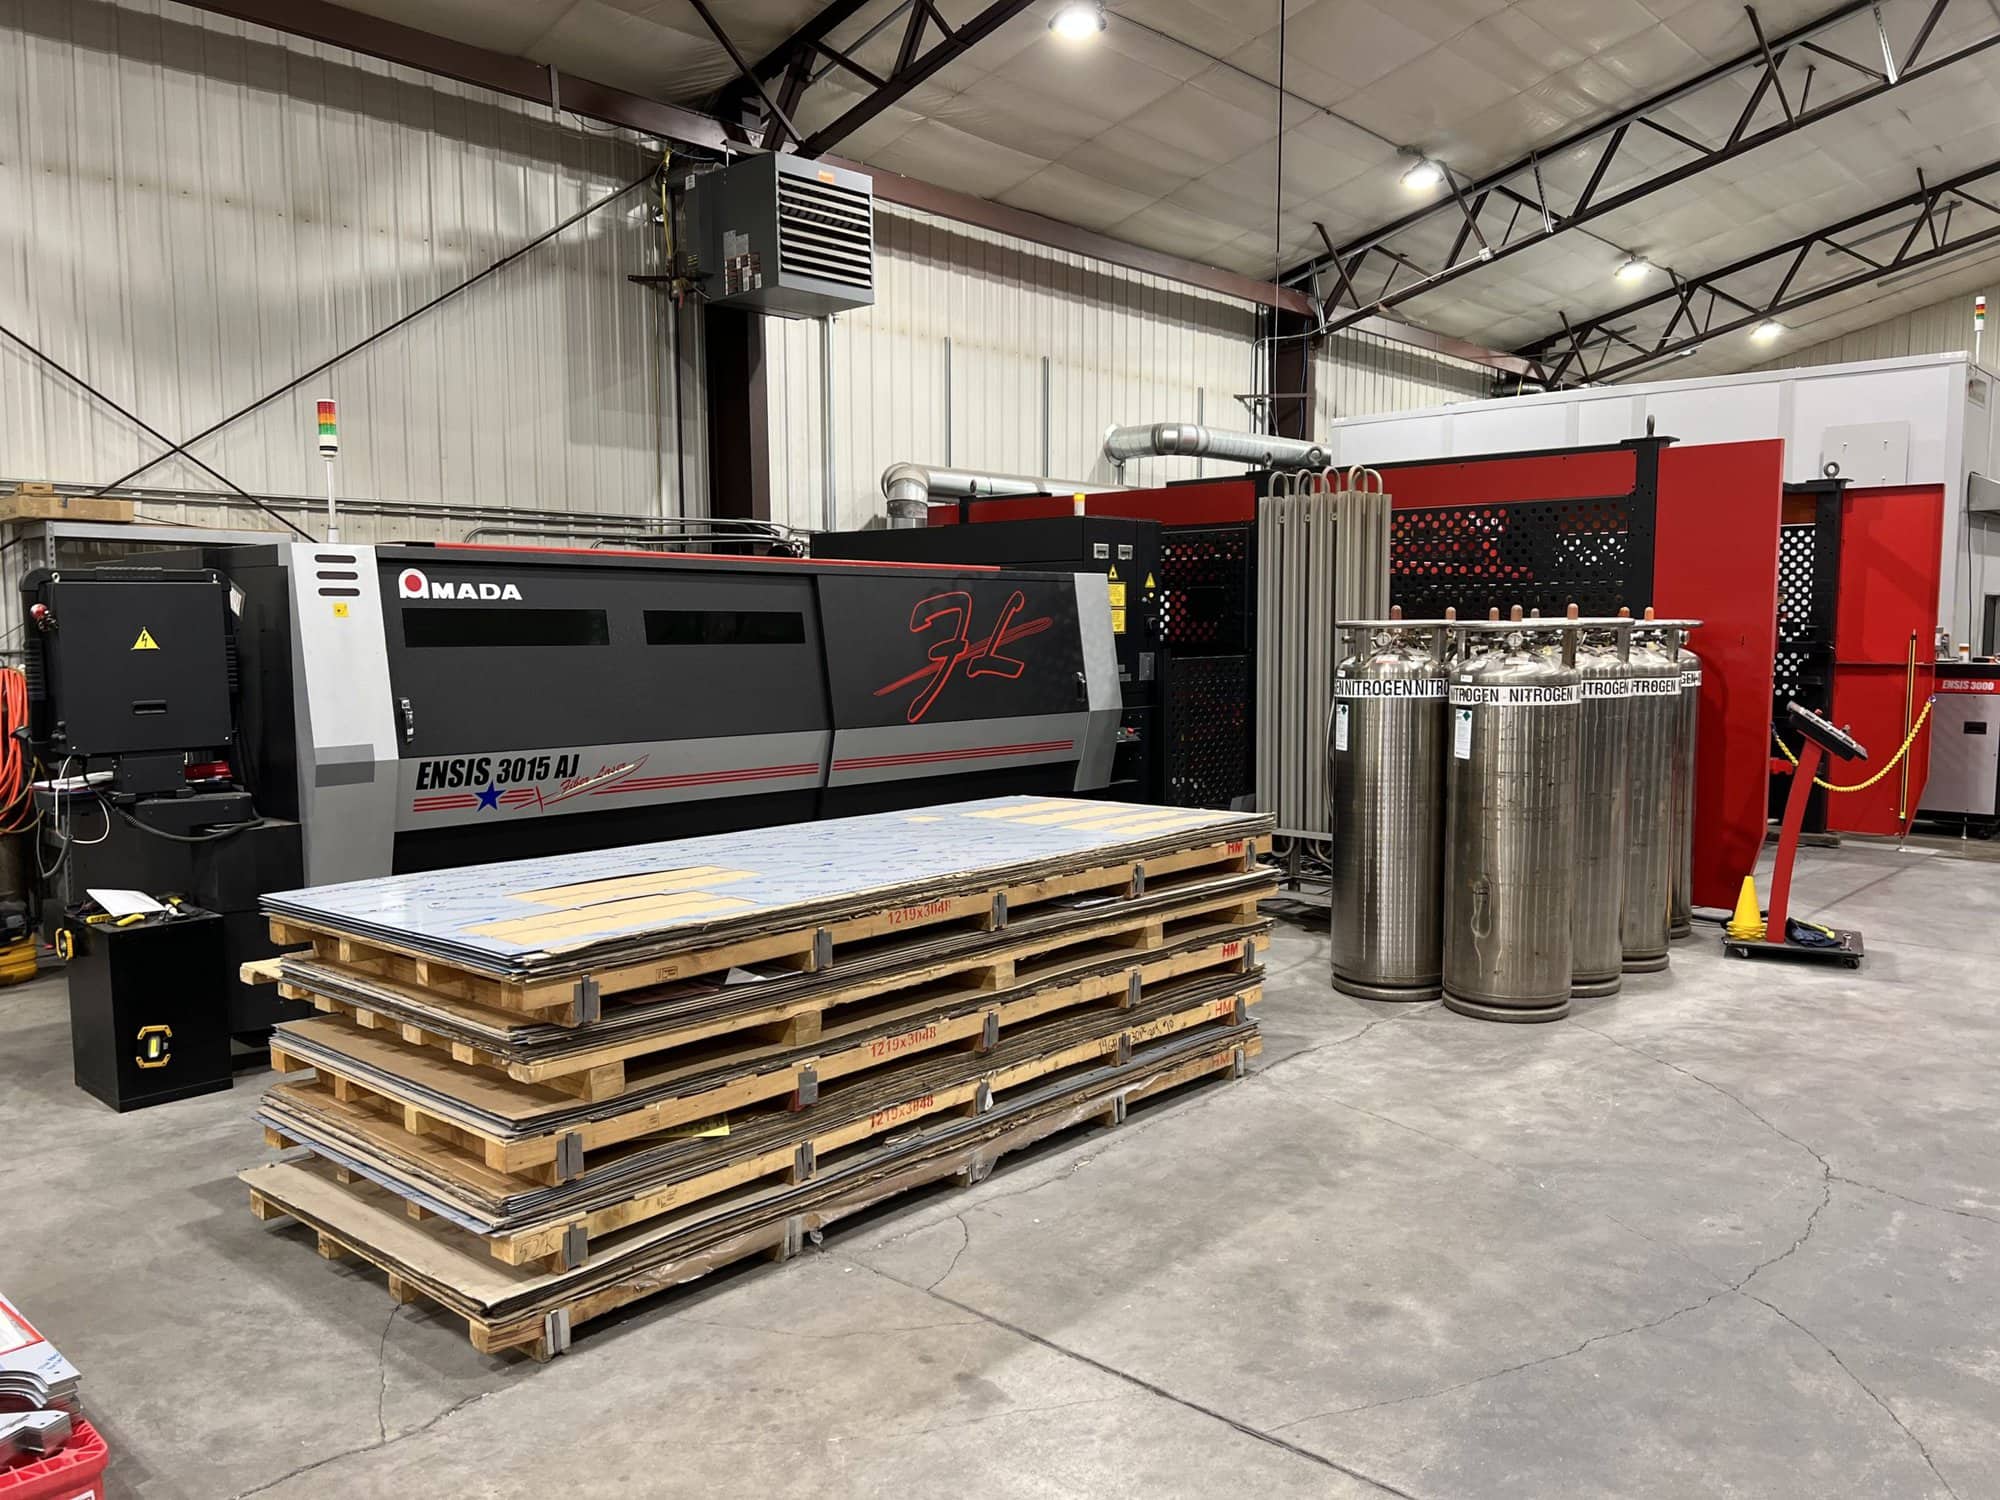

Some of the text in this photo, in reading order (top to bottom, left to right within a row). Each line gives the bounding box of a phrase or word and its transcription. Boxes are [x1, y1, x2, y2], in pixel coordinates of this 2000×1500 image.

[398, 568, 523, 601] AMADA
[1345, 680, 1412, 696] NITROGEN
[1970, 681, 1995, 690] 3000
[1509, 687, 1573, 703] NITROGEN
[416, 753, 580, 790] ENSIS 3015 AJ
[1222, 943, 1238, 957] HM
[1215, 999, 1233, 1016] HM
